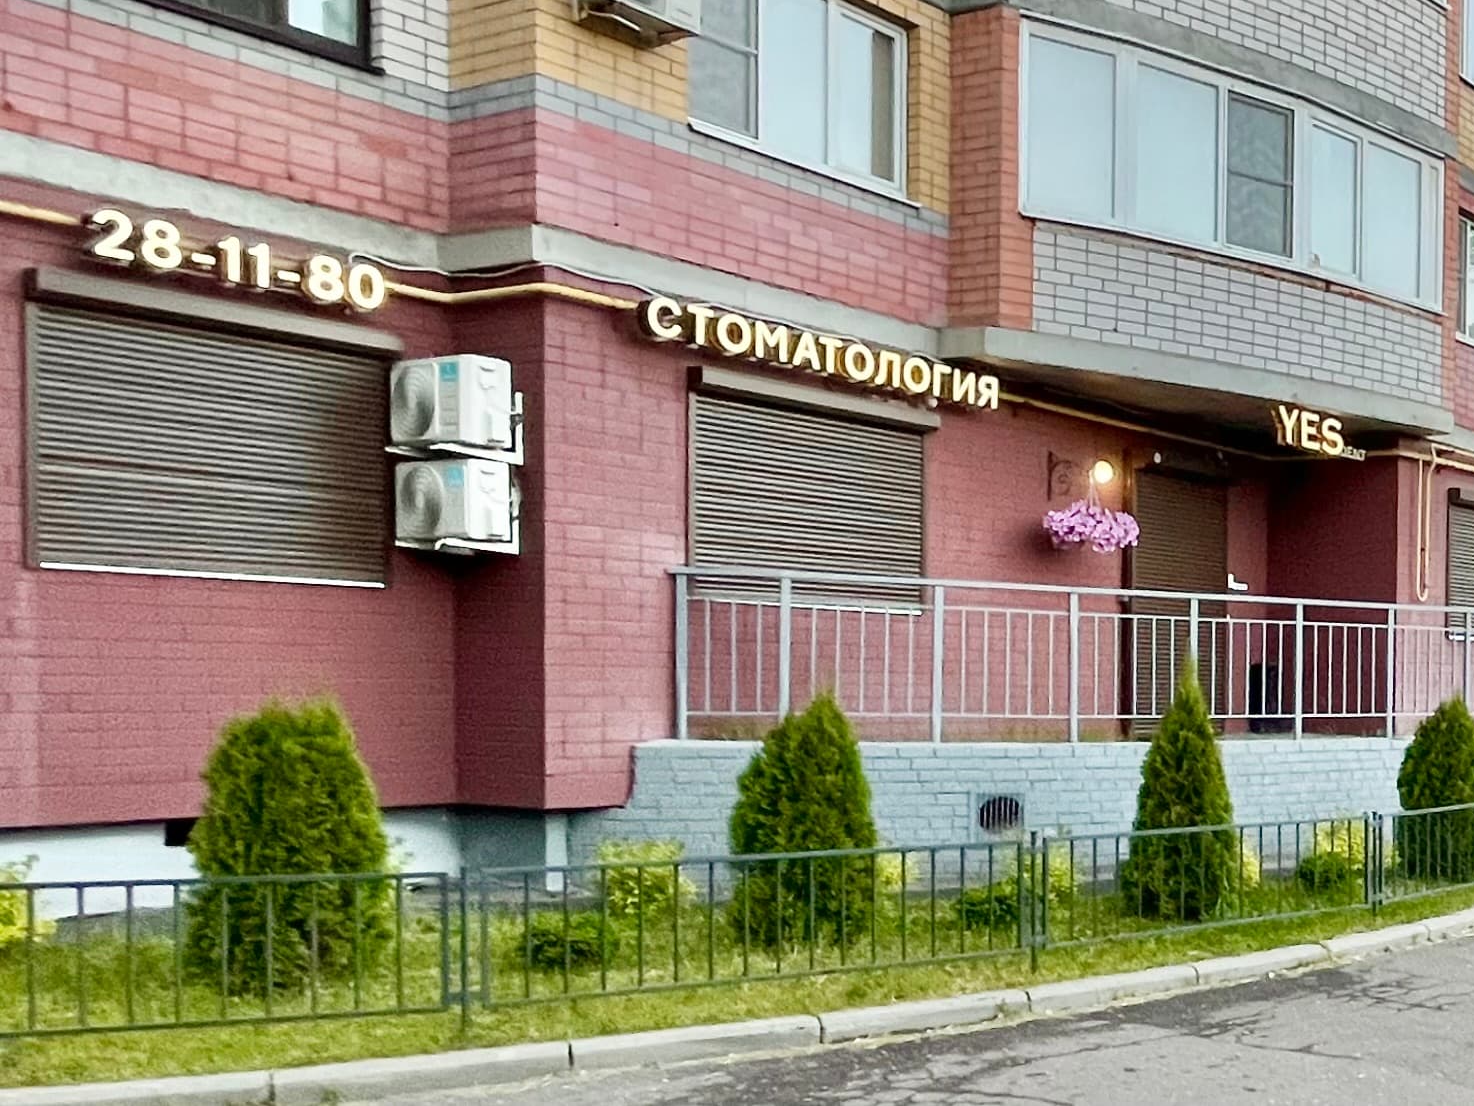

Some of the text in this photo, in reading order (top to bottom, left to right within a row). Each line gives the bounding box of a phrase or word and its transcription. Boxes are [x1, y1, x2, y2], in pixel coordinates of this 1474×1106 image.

[92, 209, 386, 309] 28-11-80
[647, 297, 1000, 410] СТОМАТОЛОГИЯ
[1278, 405, 1344, 456] YES
